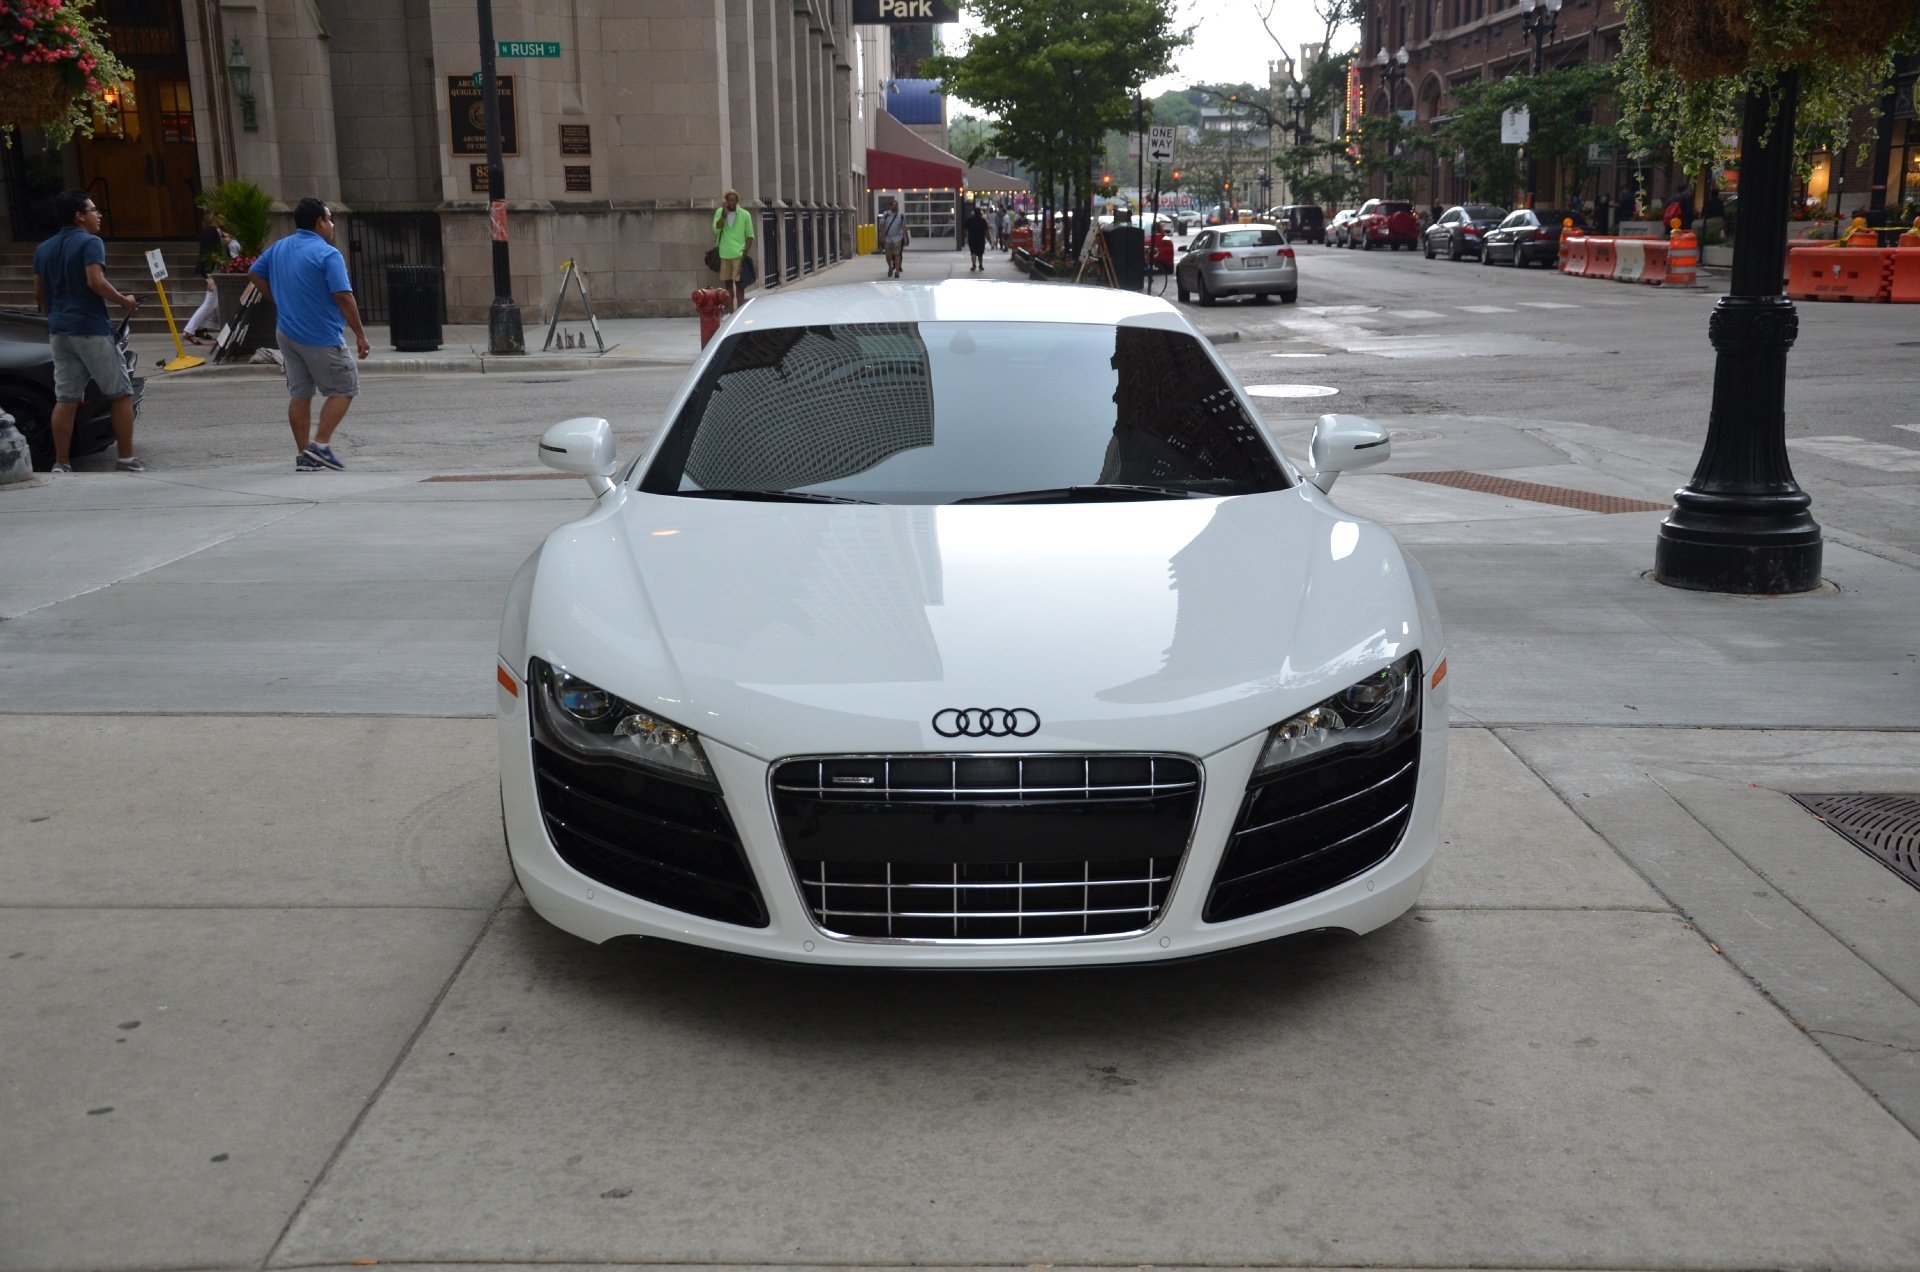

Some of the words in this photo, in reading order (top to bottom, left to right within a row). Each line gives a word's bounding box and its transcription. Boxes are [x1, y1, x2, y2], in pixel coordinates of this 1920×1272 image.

[879, 0, 934, 17] Park
[502, 45, 508, 53] N
[511, 43, 545, 56] RUSH
[548, 46, 556, 54] ST
[450, 88, 482, 96] QUIGLEY
[1152, 127, 1173, 138] ONE
[1151, 138, 1173, 149] WAY
